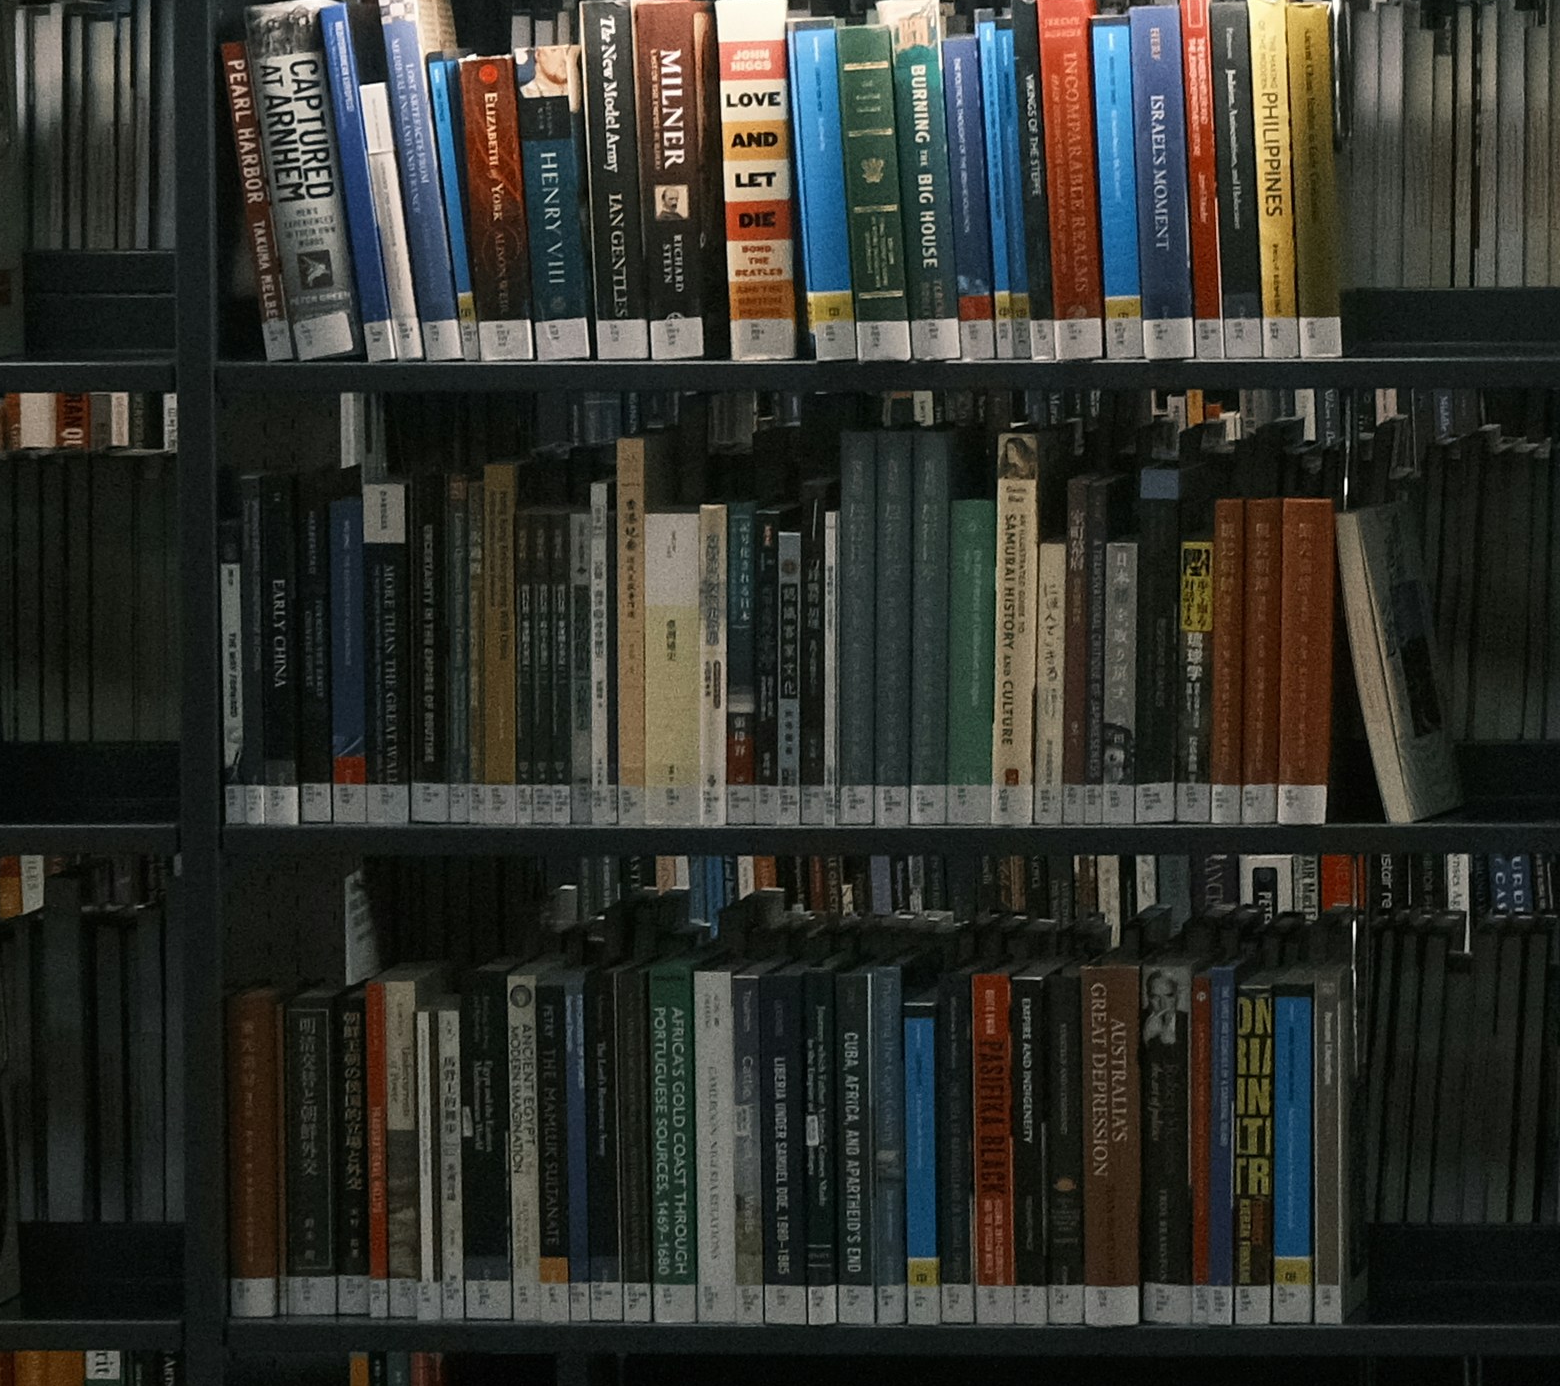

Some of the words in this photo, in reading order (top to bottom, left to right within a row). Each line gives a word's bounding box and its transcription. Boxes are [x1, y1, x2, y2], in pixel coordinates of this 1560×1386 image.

[599, 14, 616, 43] The
[228, 59, 256, 123] PEARL
[260, 65, 283, 88] AT
[601, 45, 617, 80] New
[289, 59, 335, 200] CAPTURED
[603, 82, 619, 130] Model
[658, 48, 685, 170] MILNER
[725, 92, 781, 108] LOVE
[911, 64, 929, 143] BURNING
[1150, 95, 1166, 165] ISRAEL'S
[263, 95, 305, 204] ARNHEM
[604, 131, 622, 173] Army
[731, 131, 779, 148] AND
[1063, 52, 1083, 214] INCOMPARABLE
[1262, 93, 1282, 216] PHILIPPINES
[234, 127, 264, 204] HARBOR
[539, 152, 560, 233] HENRY
[734, 172, 777, 188] LET
[917, 174, 933, 204] BIG
[608, 194, 625, 227] IAN
[739, 213, 777, 229] DIE
[920, 210, 939, 268] HOUSE
[1154, 169, 1170, 252] MOMENT
[251, 220, 272, 272] TAKUMA
[547, 240, 566, 284] VIII
[609, 230, 629, 317] GENTLES
[1072, 217, 1089, 293] REALMS
[1002, 514, 1016, 582] SAMURAI
[271, 578, 286, 630] EARLY
[1003, 587, 1016, 650] HISTORY
[273, 635, 287, 688] CHINA
[1001, 680, 1014, 746] CULTURE
[671, 1007, 686, 1076] AFRICA'S
[1089, 982, 1105, 1049] GREAT
[842, 1032, 860, 1070] CUBA,
[1109, 1019, 1128, 1143] AUSTRALIA'S
[672, 1081, 686, 1127] GOLD
[843, 1075, 860, 1126] AFRICA,
[1091, 1054, 1108, 1178] DEPRESSION
[672, 1132, 686, 1185] COAST
[845, 1130, 860, 1156] AND
[845, 1159, 861, 1244] APARTHEID'S
[673, 1192, 687, 1275] THROUGH
[846, 1247, 862, 1272] END
